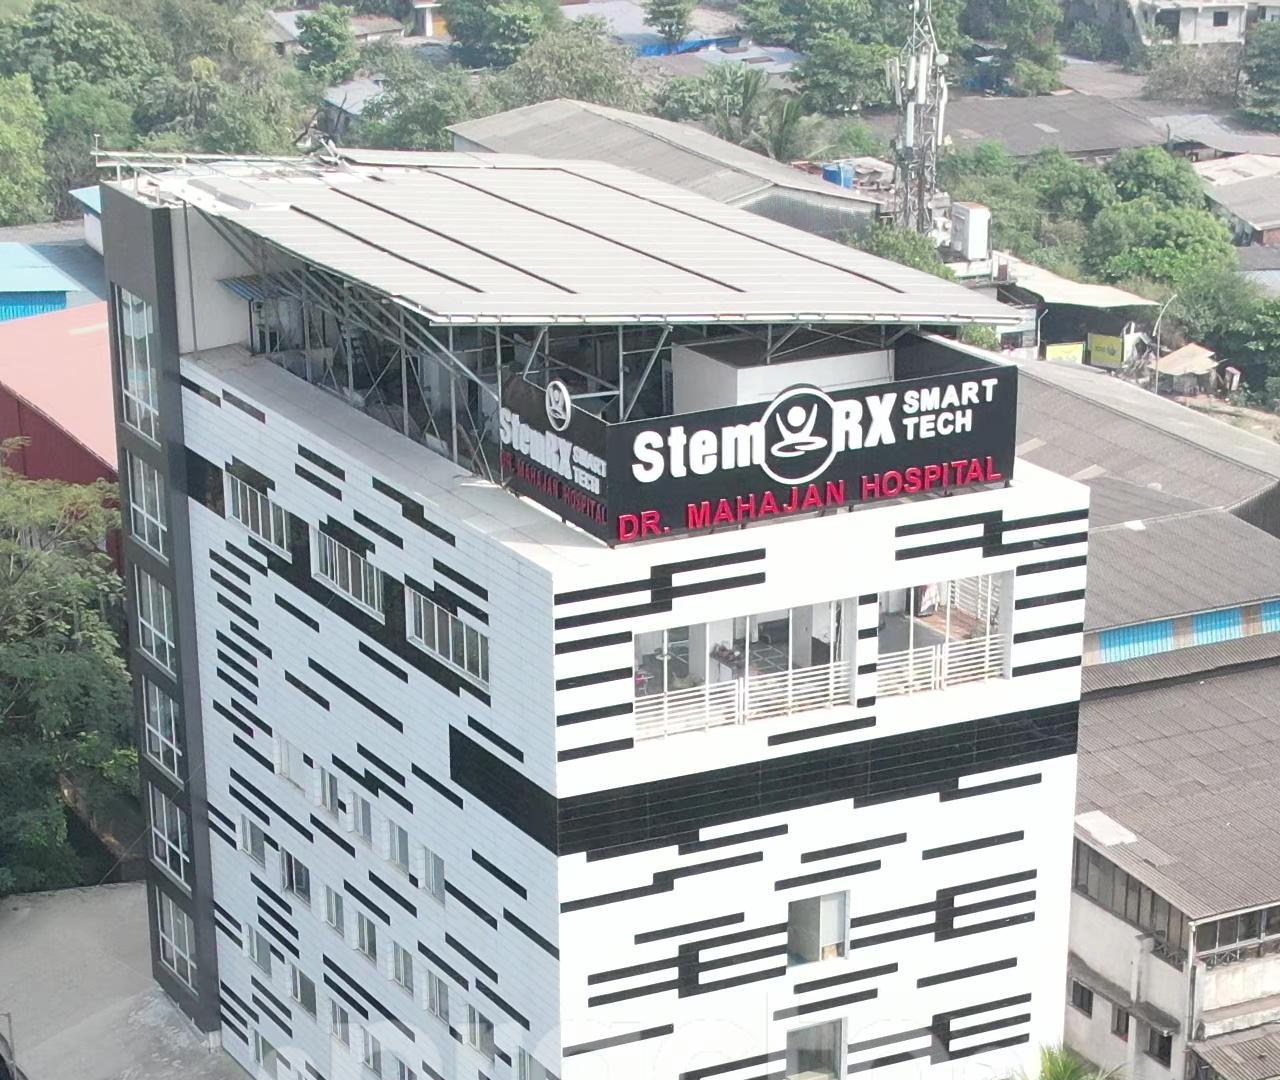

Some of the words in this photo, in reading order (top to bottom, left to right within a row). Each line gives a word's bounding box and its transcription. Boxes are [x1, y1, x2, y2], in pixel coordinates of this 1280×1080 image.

[902, 378, 998, 414] SMART
[631, 421, 766, 483] Stem
[832, 393, 898, 453] RX
[901, 409, 973, 441] TECH
[572, 445, 607, 478] SMART
[572, 465, 600, 495] TECH
[563, 486, 608, 525] HOSPITAL
[618, 510, 671, 542] DR.
[686, 479, 845, 529] MAHAJAN
[861, 456, 1002, 501] HOSPITAL
